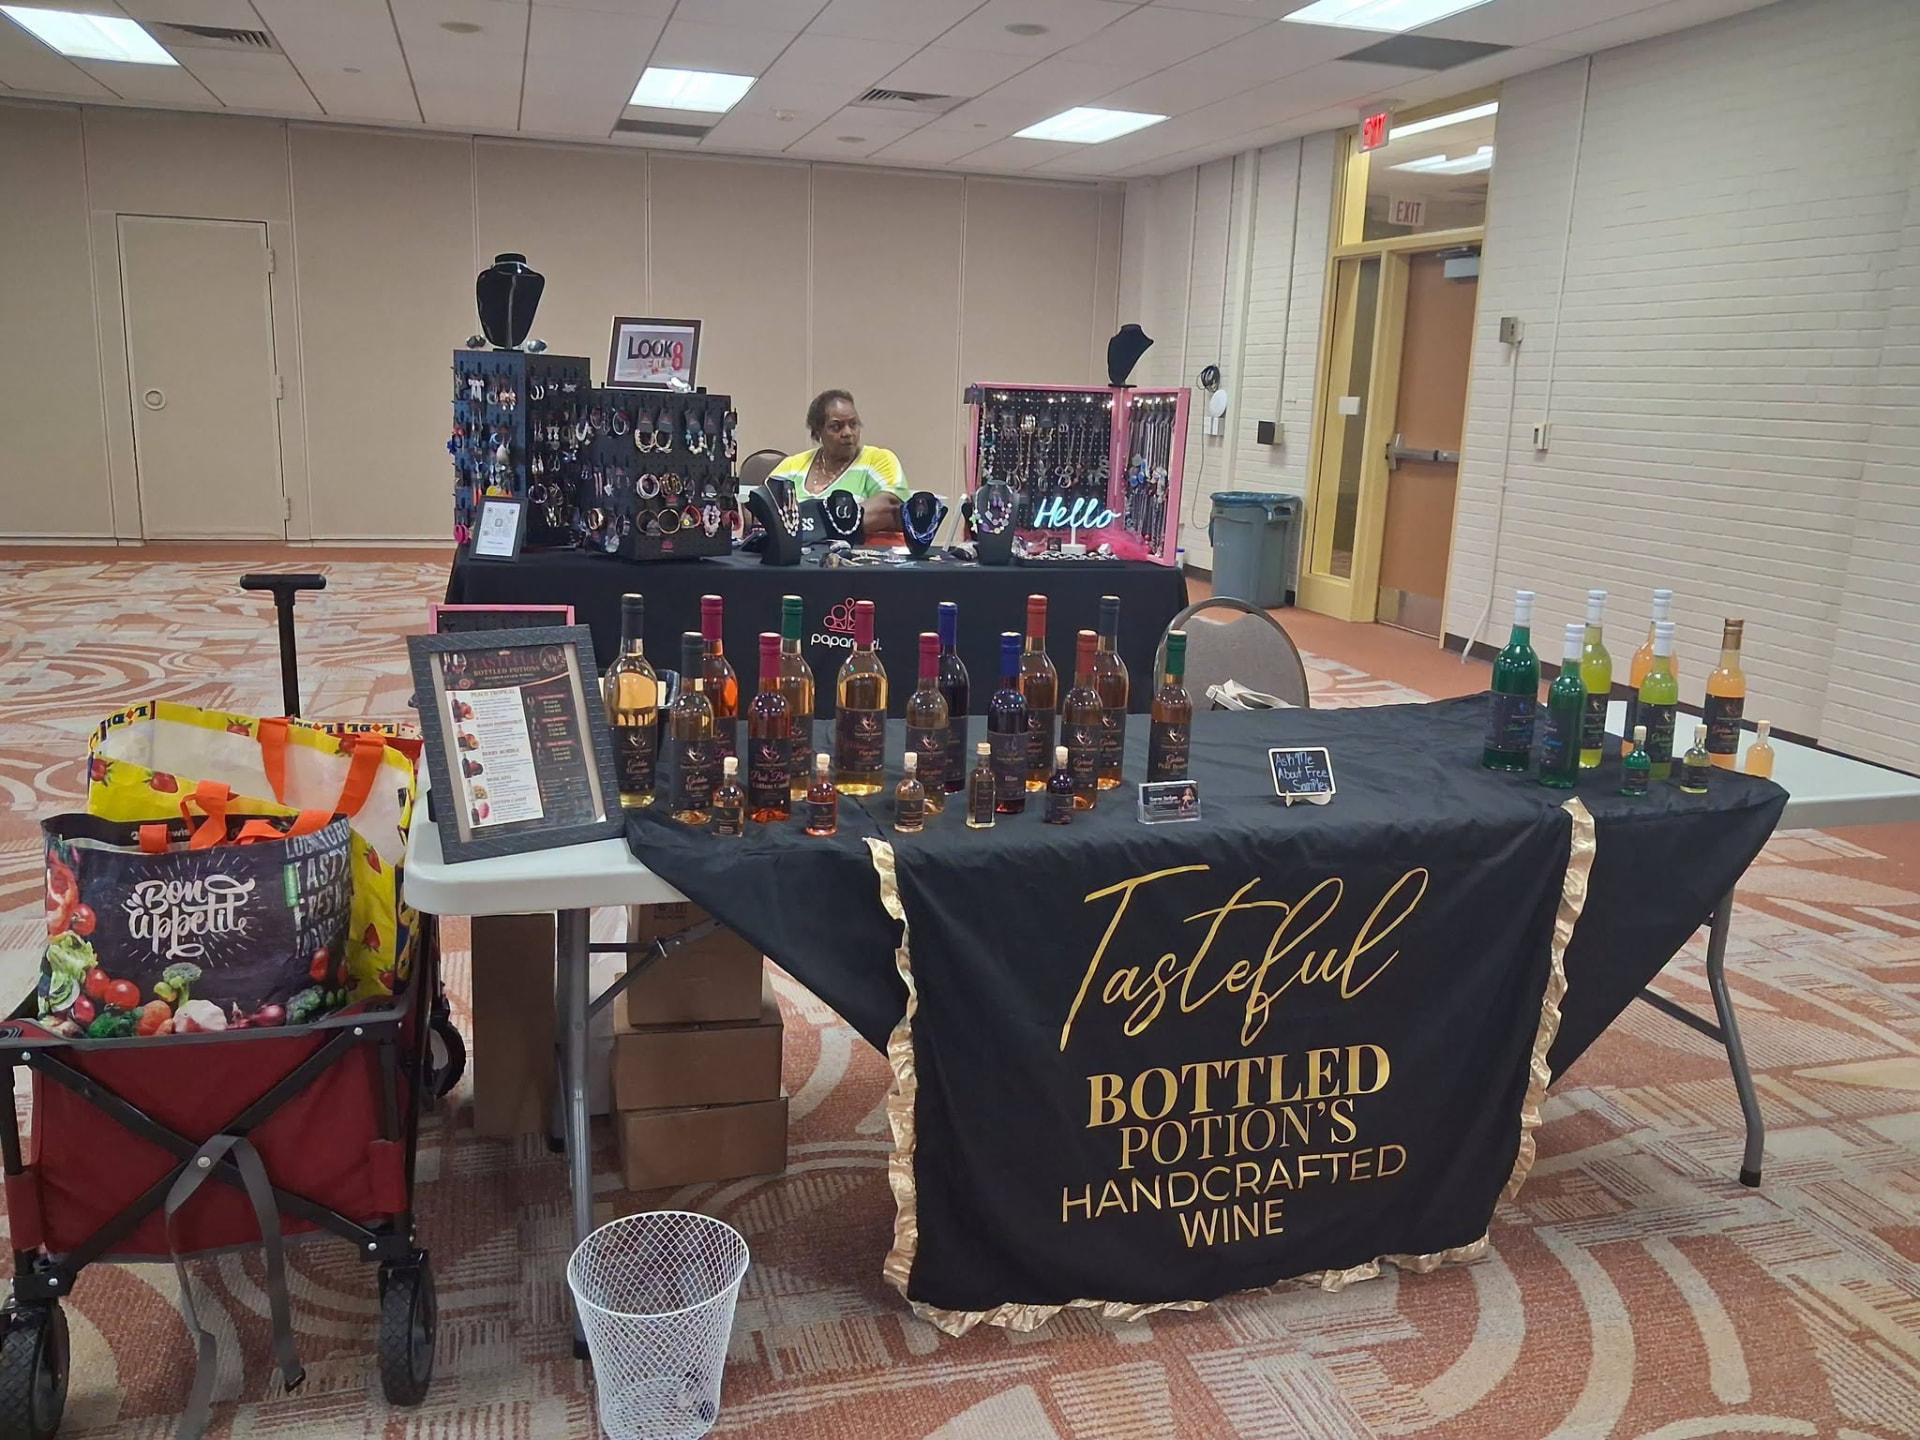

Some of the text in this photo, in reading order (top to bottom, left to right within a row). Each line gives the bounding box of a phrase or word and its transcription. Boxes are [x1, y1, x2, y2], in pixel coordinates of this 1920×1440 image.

[1363, 112, 1387, 148] EXIT
[1396, 200, 1422, 224] EXIT
[627, 335, 673, 359] LOOK
[1033, 496, 1121, 528] Hello
[1278, 766, 1328, 780] About Free
[135, 880, 208, 914] Bon
[1059, 864, 1429, 1051] Tasteful
[1085, 1043, 1391, 1128] BOTTLED
[1118, 1098, 1357, 1170] POTION'S
[1061, 1144, 1407, 1222] HANDCRAFTED
[1179, 1198, 1284, 1248] WINE
